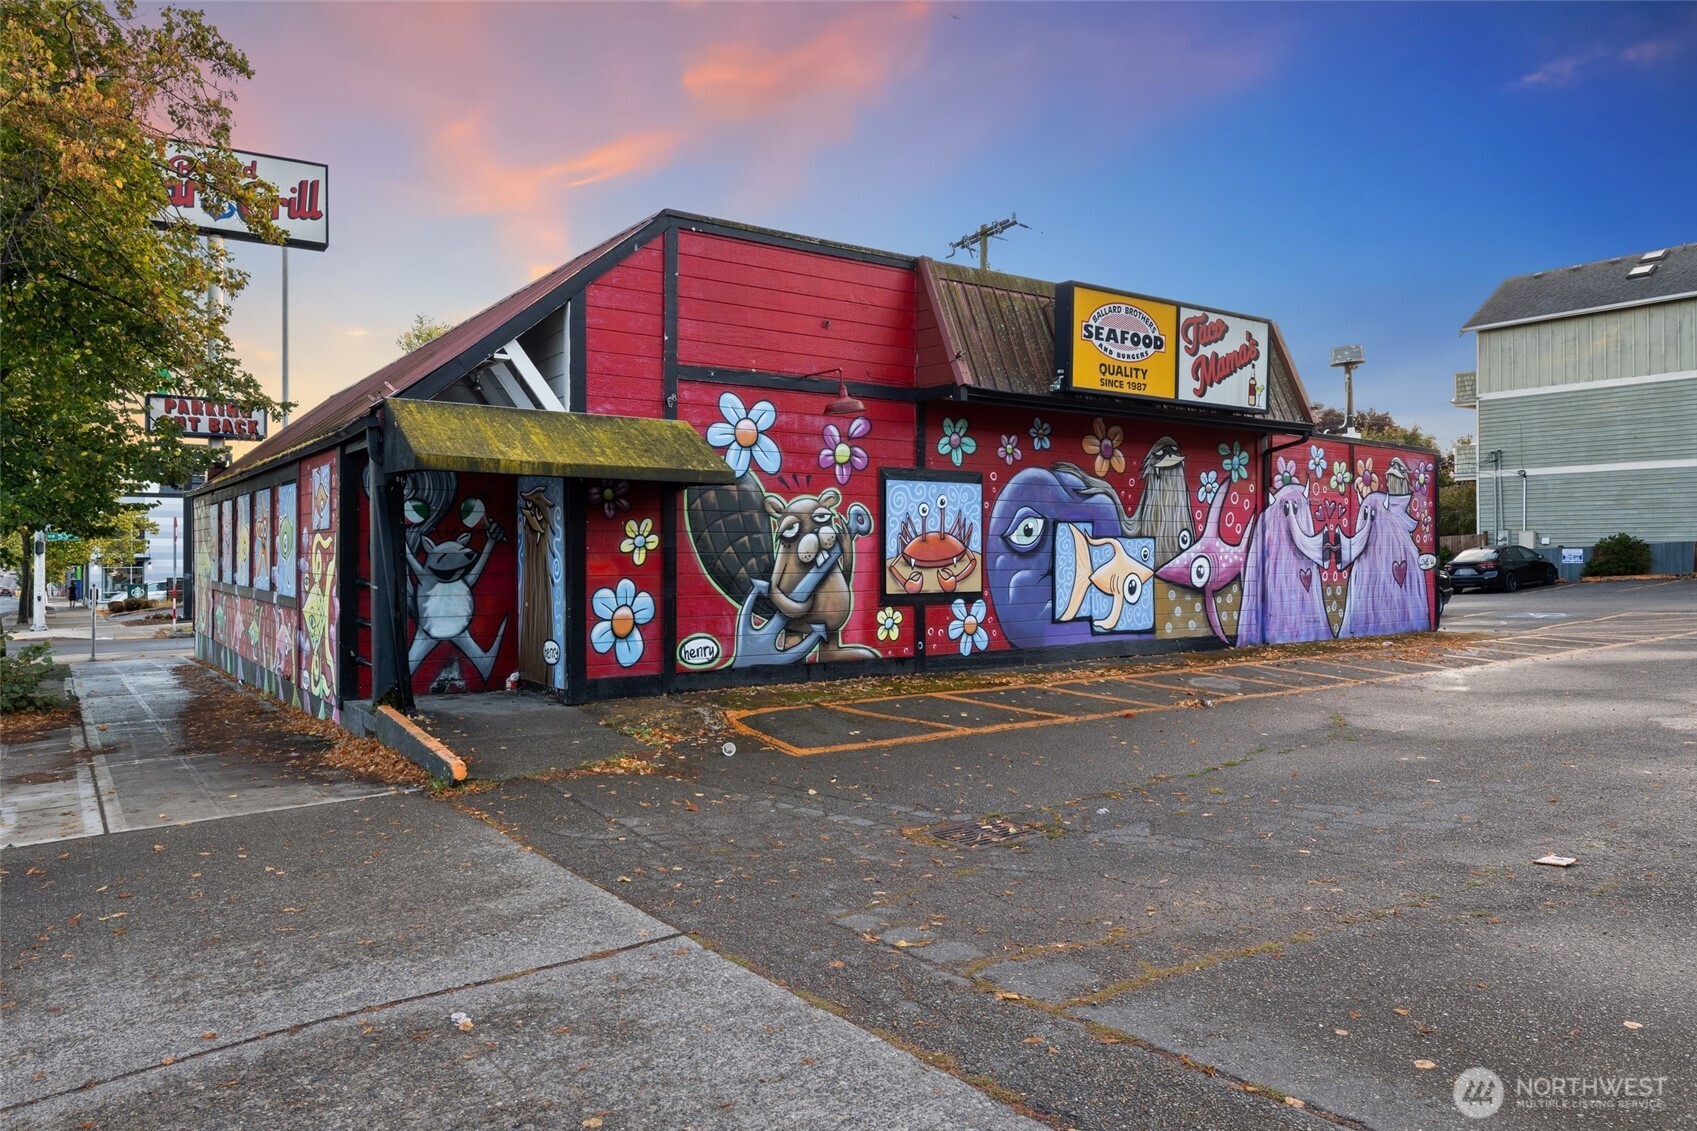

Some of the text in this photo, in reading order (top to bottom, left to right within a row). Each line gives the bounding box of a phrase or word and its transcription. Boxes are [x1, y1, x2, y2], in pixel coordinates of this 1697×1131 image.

[1092, 306, 1157, 334] BALLARD BROTHERS
[1083, 324, 1164, 350] SEAFOOD
[1181, 312, 1229, 357] Taco
[1098, 342, 1149, 360] AND BURGERS
[1099, 362, 1148, 380] QUALITY
[1191, 330, 1260, 398] Mama's
[1100, 378, 1147, 391] SINCE 1987
[208, 417, 259, 436] BACK
[683, 645, 715, 661] henry
